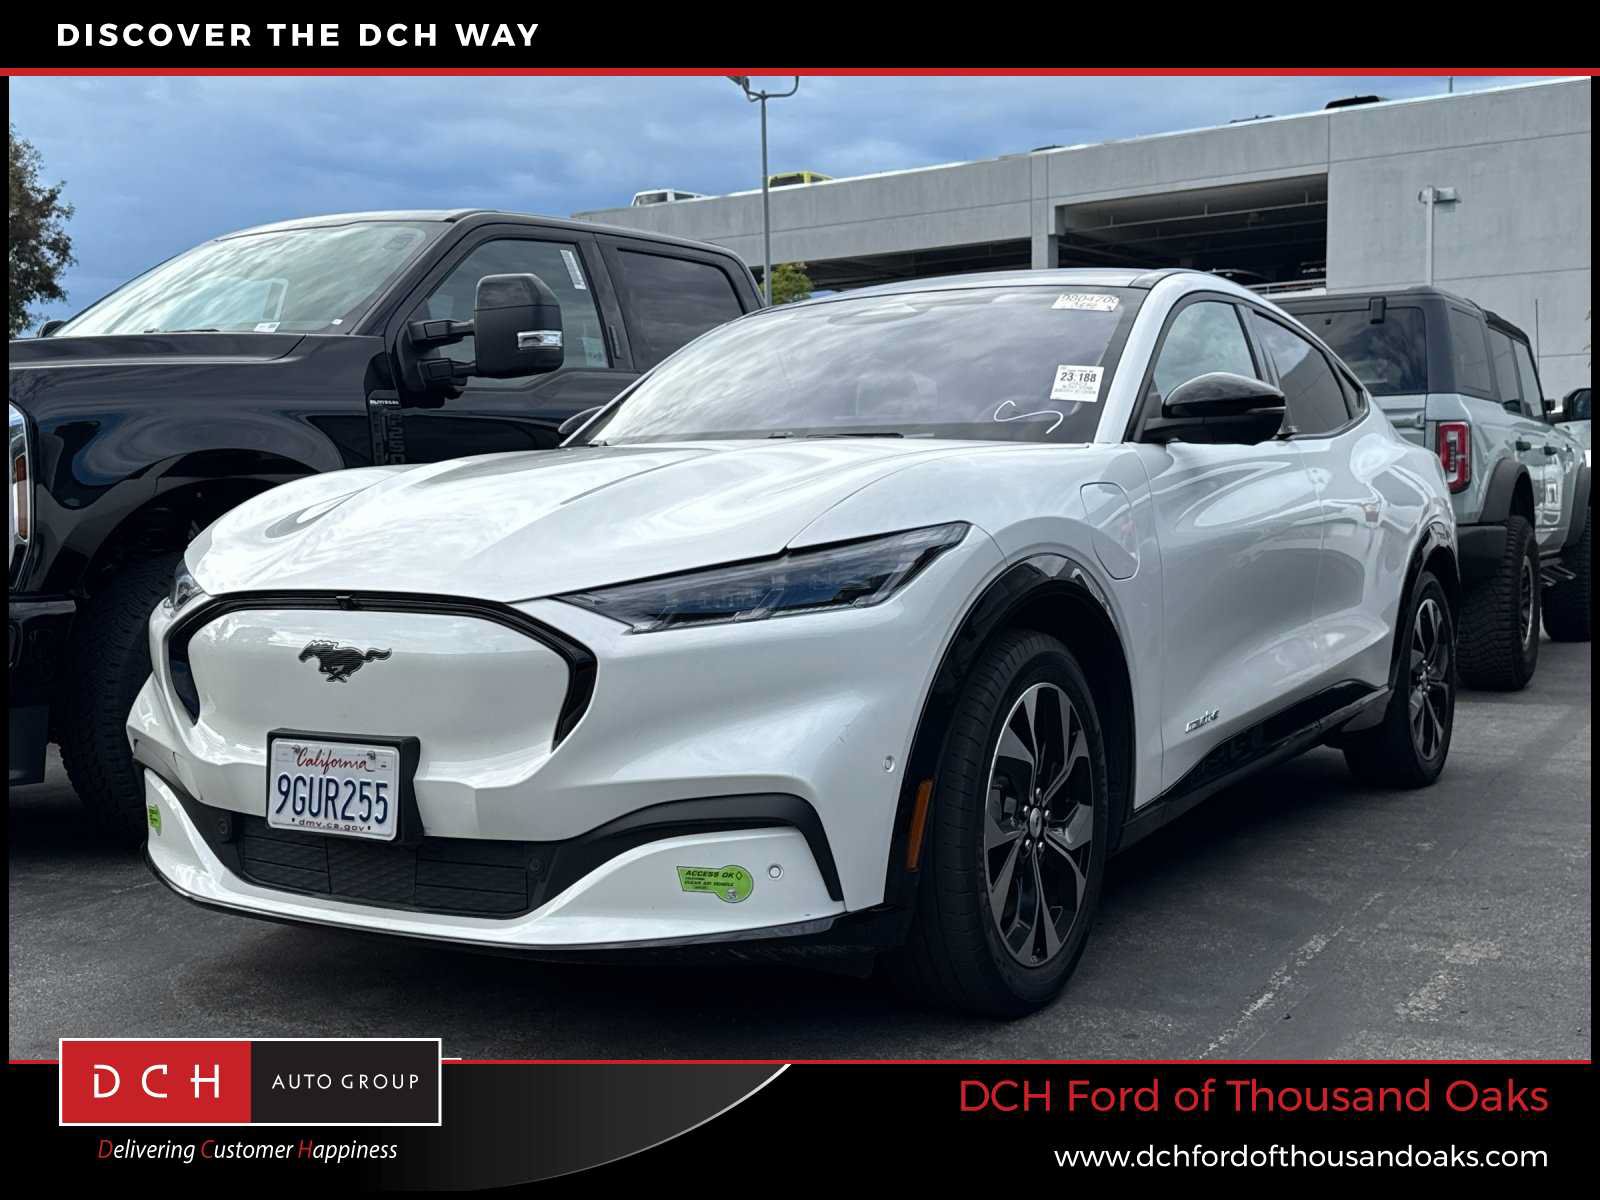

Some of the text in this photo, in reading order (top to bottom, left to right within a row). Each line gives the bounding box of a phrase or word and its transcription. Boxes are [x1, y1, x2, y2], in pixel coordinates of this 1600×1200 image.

[296, 746, 376, 775] California
[275, 773, 389, 825] 9GUR255
[298, 819, 365, 832] dmv.ca.gov
[685, 870, 719, 878] ACCESS
